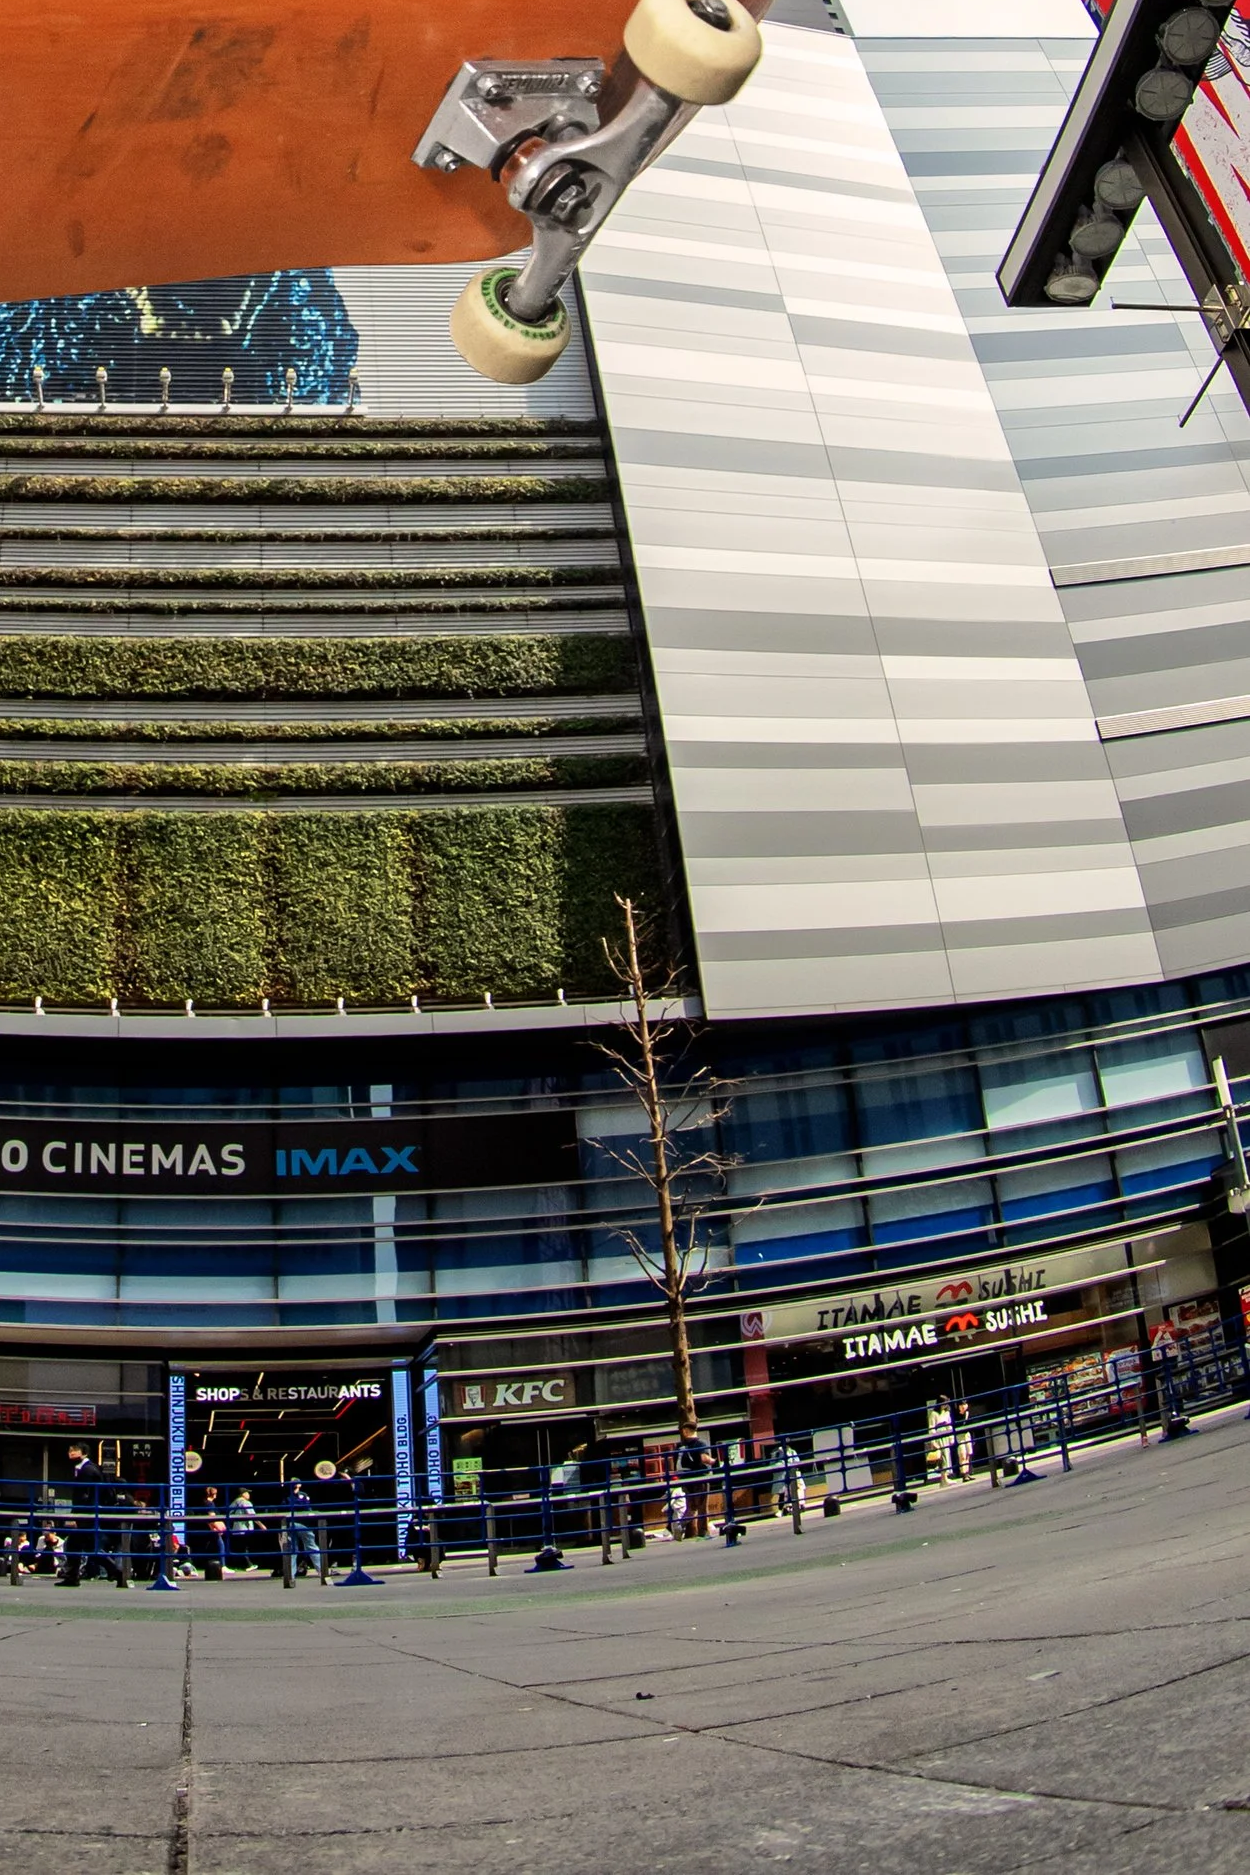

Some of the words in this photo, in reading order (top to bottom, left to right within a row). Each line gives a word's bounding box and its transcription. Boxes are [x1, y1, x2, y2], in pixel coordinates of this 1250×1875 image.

[43, 1141, 246, 1176] CINEMAS
[276, 1145, 419, 1177] IMAX
[817, 1295, 922, 1331] ITAMAE
[842, 1325, 939, 1359] ITAMAE
[171, 1375, 185, 1443] SHINJUKU
[196, 1387, 249, 1401] SHOPS
[253, 1388, 263, 1401] &
[267, 1384, 382, 1401] RESTAURANTS
[493, 1379, 565, 1407] KFC
[396, 1413, 408, 1447] BLDG.
[171, 1446, 185, 1484] TOHO
